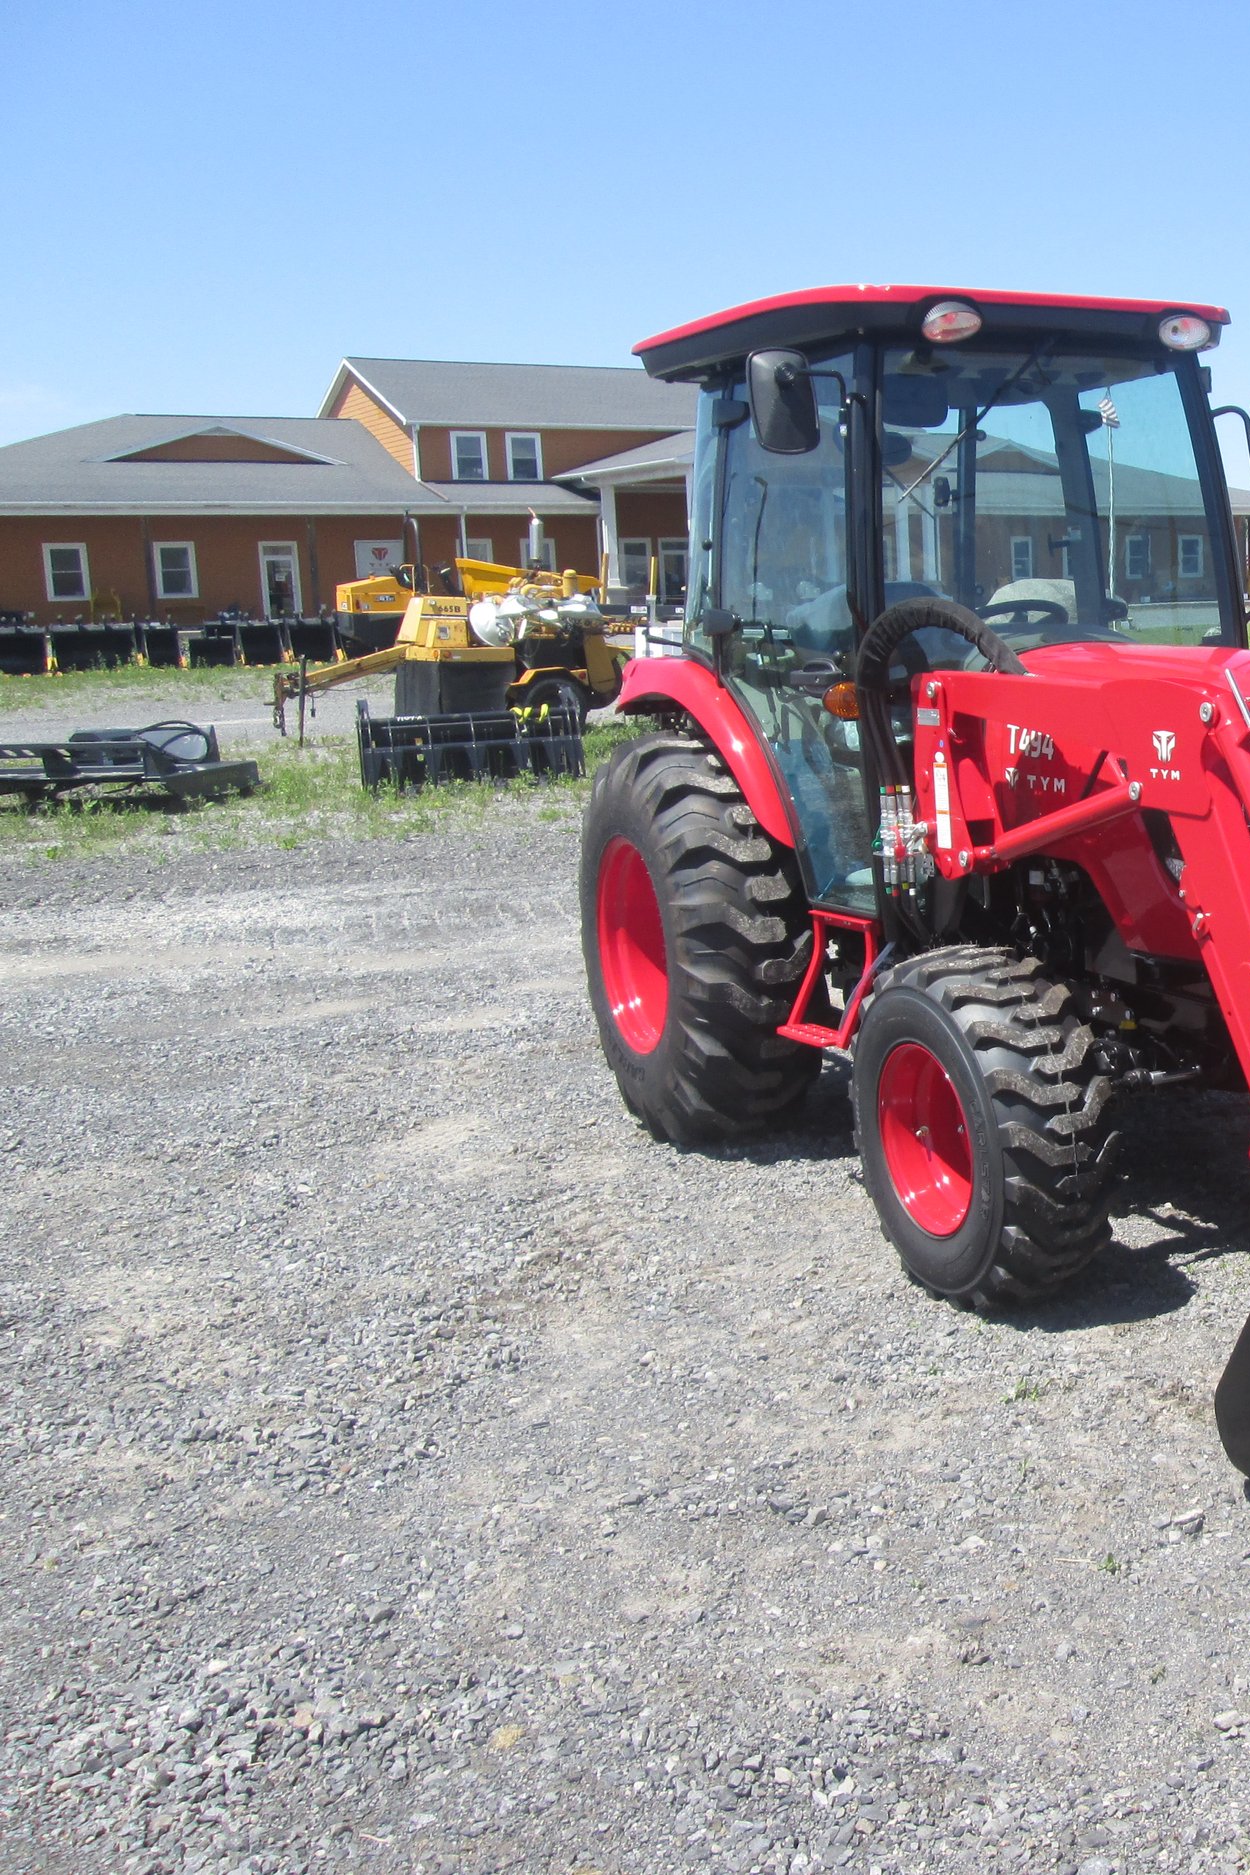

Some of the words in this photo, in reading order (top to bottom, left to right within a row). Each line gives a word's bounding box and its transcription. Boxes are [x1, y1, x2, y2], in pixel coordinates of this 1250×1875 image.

[1006, 723, 1055, 761] T494
[1026, 774, 1066, 793] TYM
[1149, 768, 1180, 781] TYM
